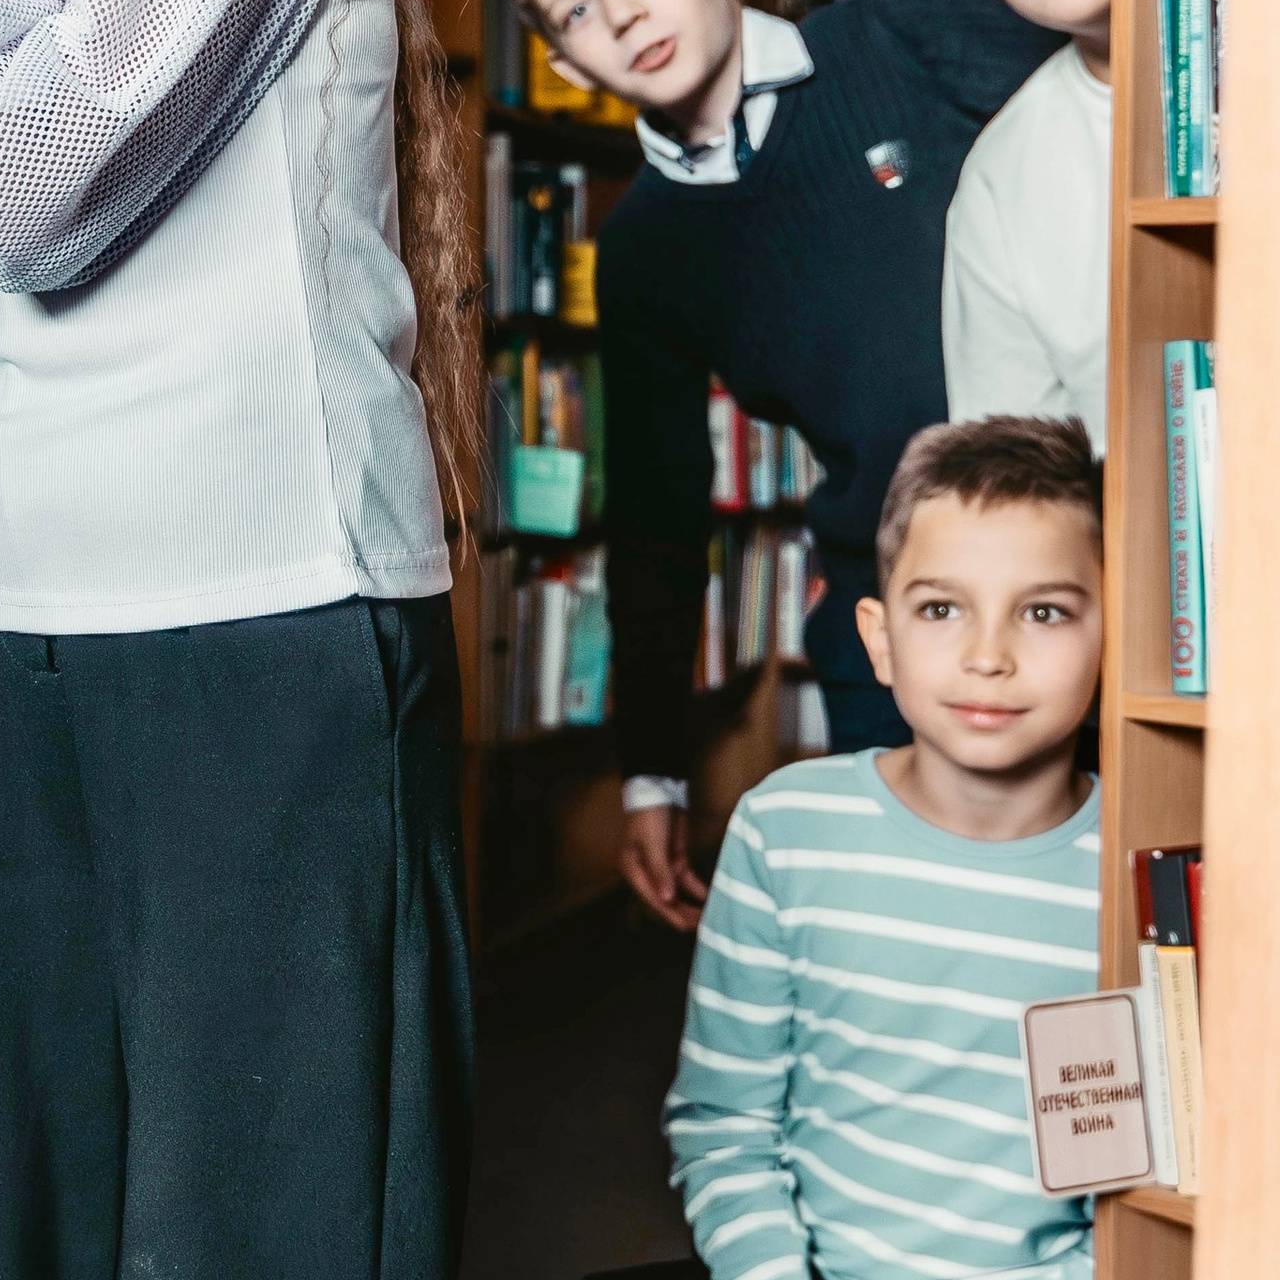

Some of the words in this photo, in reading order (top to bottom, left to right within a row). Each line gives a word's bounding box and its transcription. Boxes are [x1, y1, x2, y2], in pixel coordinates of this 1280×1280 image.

[1058, 1059, 1116, 1084] ВЕЛИКАЯ
[1038, 1081, 1142, 1113] ОТЕЧЕСТВЕННАЯ
[1071, 1111, 1114, 1135] ВОЙНА
